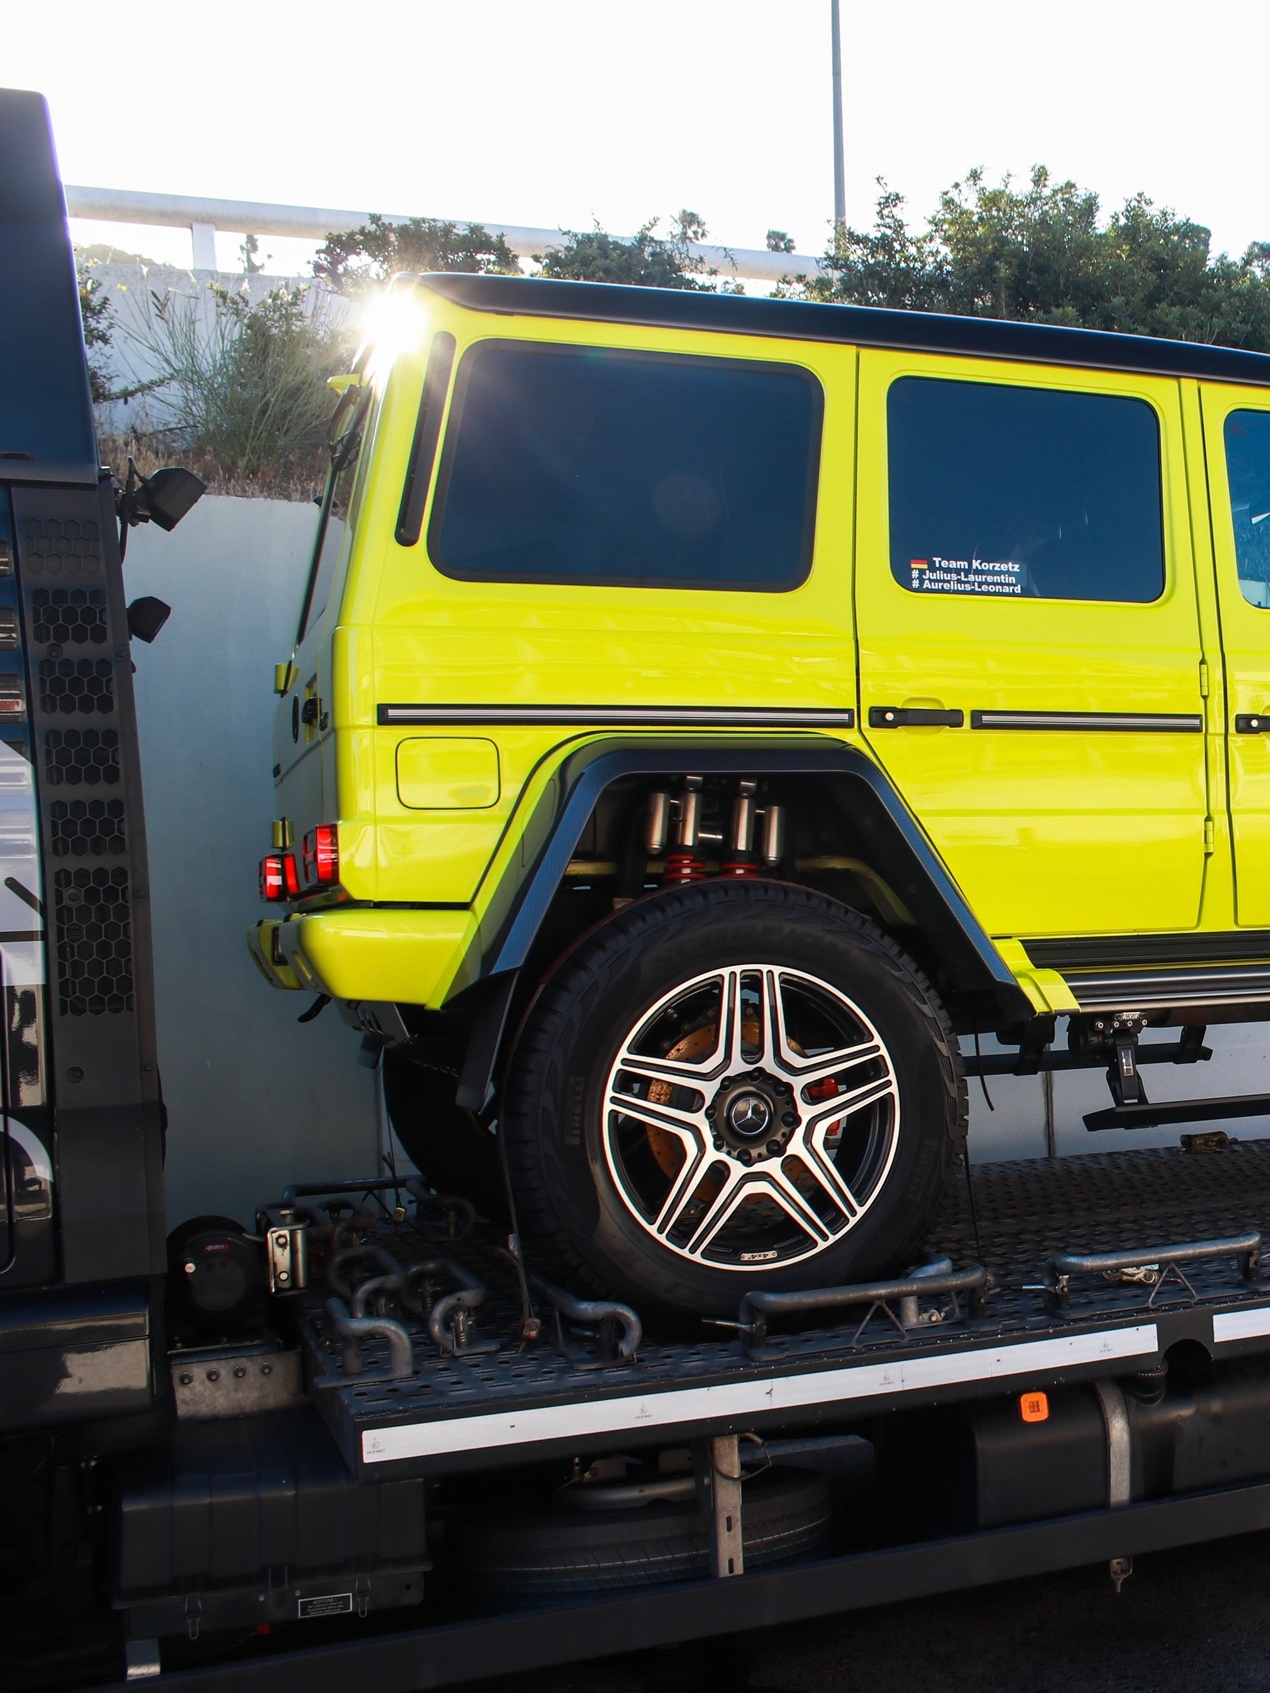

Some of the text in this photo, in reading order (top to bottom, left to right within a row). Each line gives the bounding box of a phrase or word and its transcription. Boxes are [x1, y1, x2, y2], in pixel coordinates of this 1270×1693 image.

[932, 556, 1020, 572] Team Korzetz
[922, 569, 1016, 584] Julius-Laurentin
[922, 579, 1022, 594] Aurelius-Leonard
[564, 1075, 585, 1146] PIRELLI
